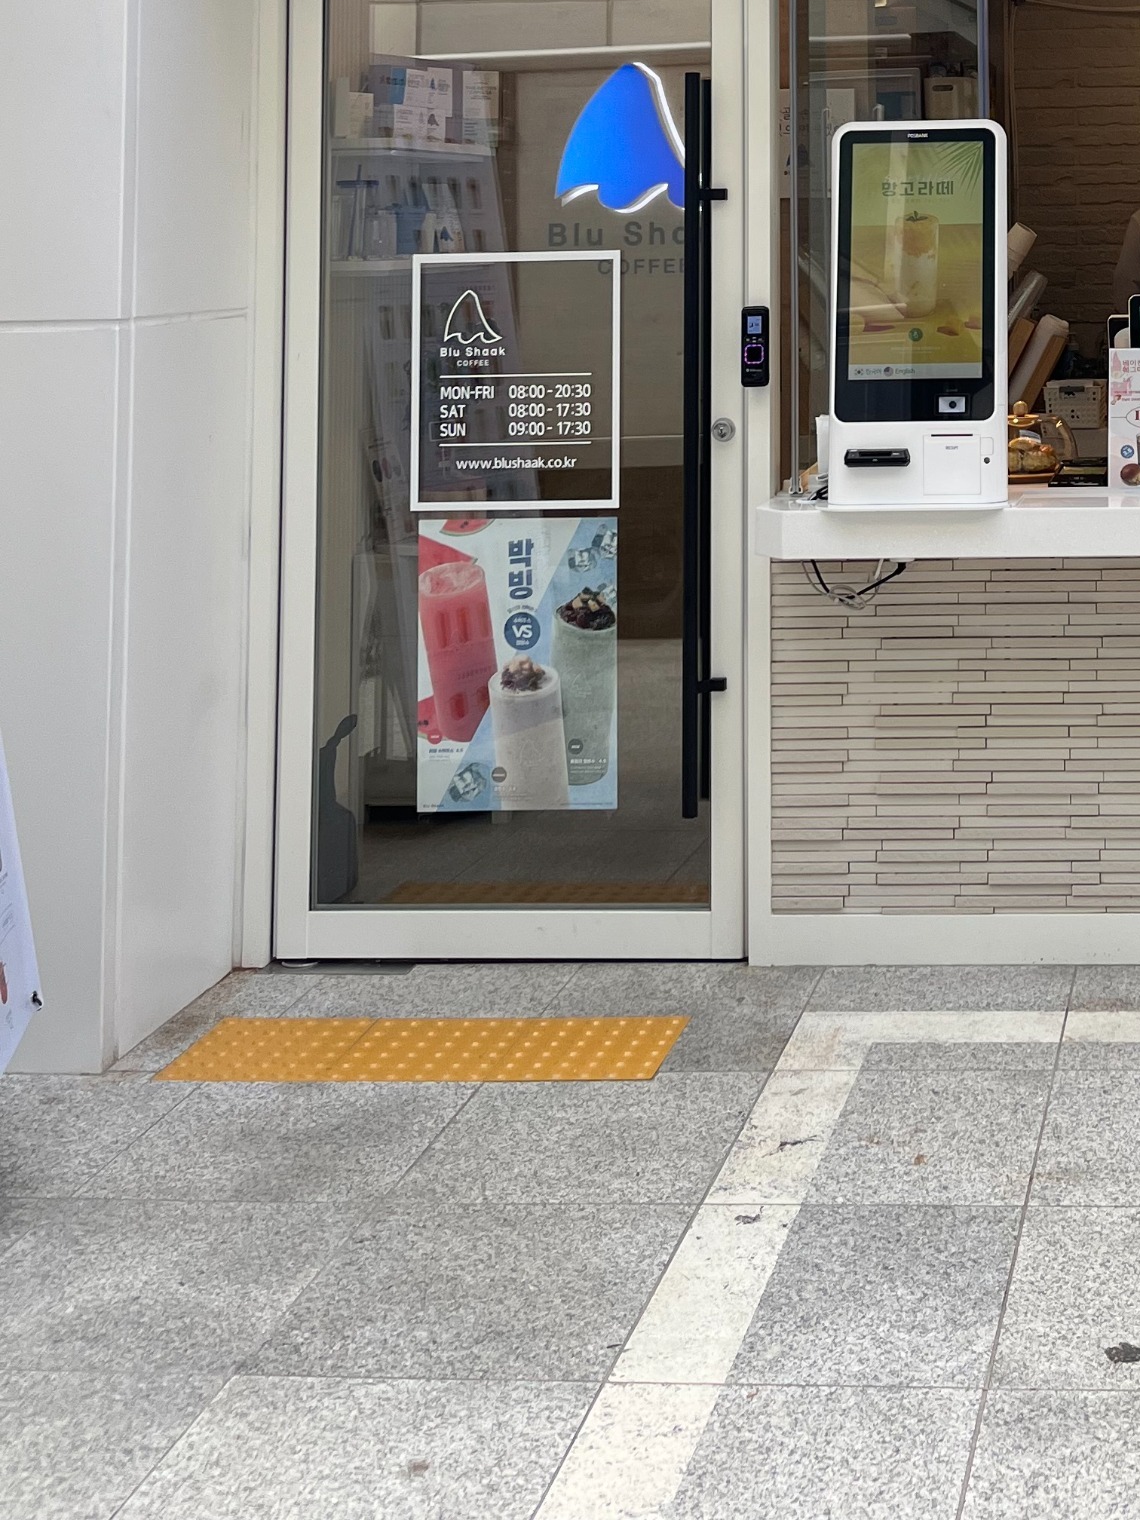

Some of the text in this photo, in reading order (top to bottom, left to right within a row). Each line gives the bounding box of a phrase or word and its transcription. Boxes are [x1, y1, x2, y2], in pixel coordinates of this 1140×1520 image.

[881, 180, 954, 197] 망고라떼
[548, 221, 685, 247] Blu Sha
[440, 346, 506, 357] Blu Shaak
[456, 359, 490, 367] COFFEE
[440, 386, 495, 399] MON-FRI
[508, 385, 545, 398] 08:00
[555, 384, 591, 398] 20:30
[440, 405, 466, 418] SAT
[508, 403, 545, 417] 08:00
[556, 403, 591, 416] 17:30
[440, 423, 466, 437] SUN
[508, 422, 545, 436] 09:00
[556, 421, 591, 435] 17:30
[456, 456, 577, 469] www.blushaak.co.kr
[508, 538, 535, 600] 박빙
[511, 624, 533, 639] VS
